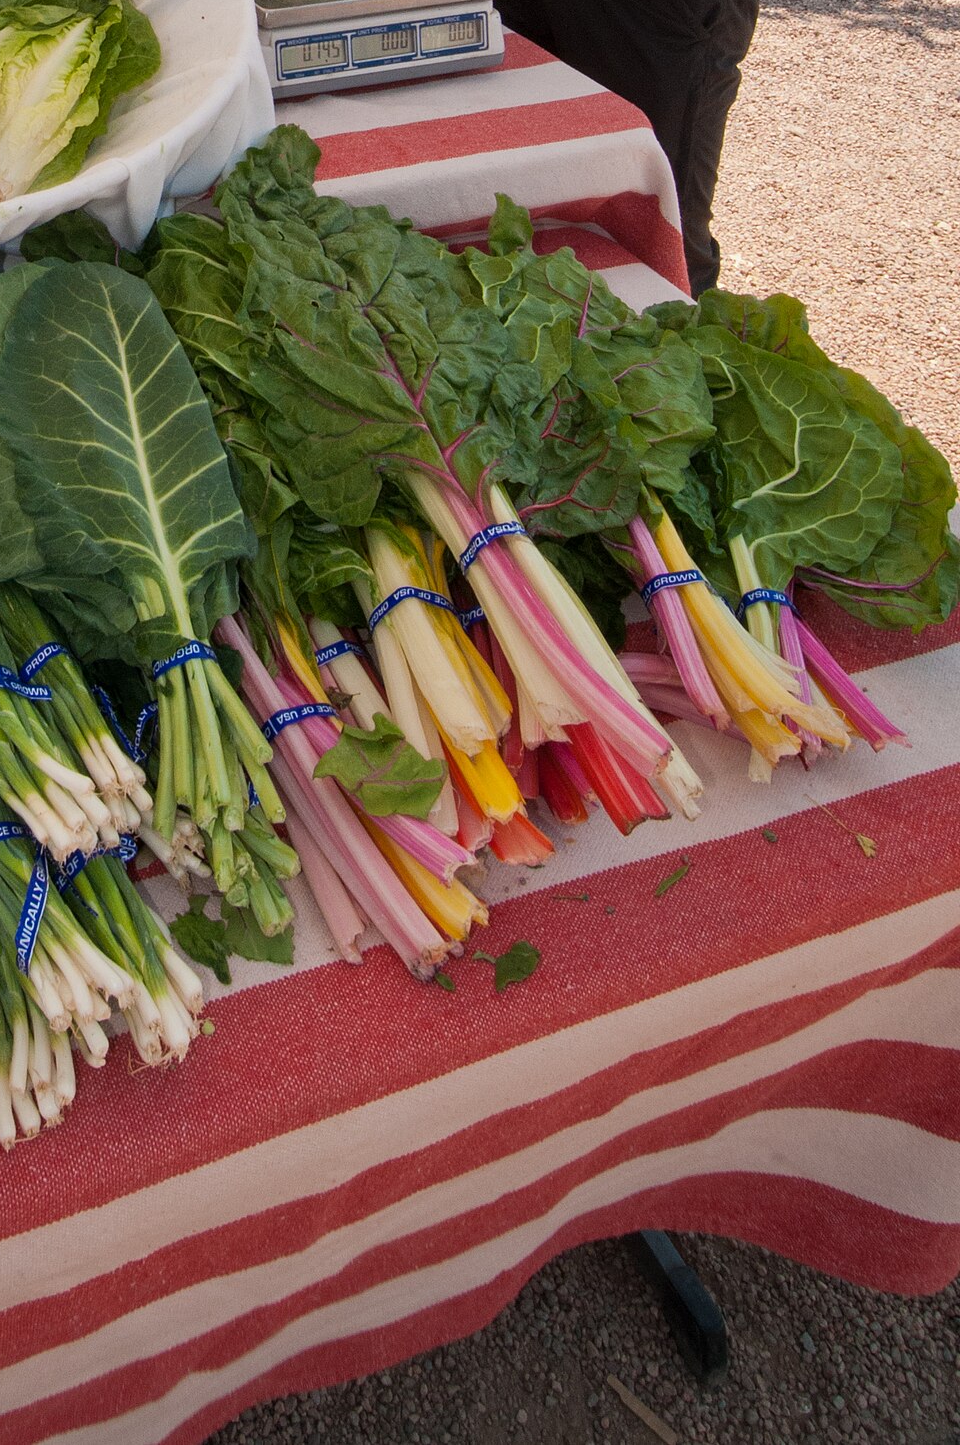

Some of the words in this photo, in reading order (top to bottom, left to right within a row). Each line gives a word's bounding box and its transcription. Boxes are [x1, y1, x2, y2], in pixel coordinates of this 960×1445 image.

[653, 572, 698, 589] GROWN
[393, 588, 415, 601] USA
[418, 591, 431, 601] OF
[748, 590, 770, 601] USA
[772, 594, 786, 602] OF
[301, 706, 315, 716] OF
[276, 710, 299, 725] USA
